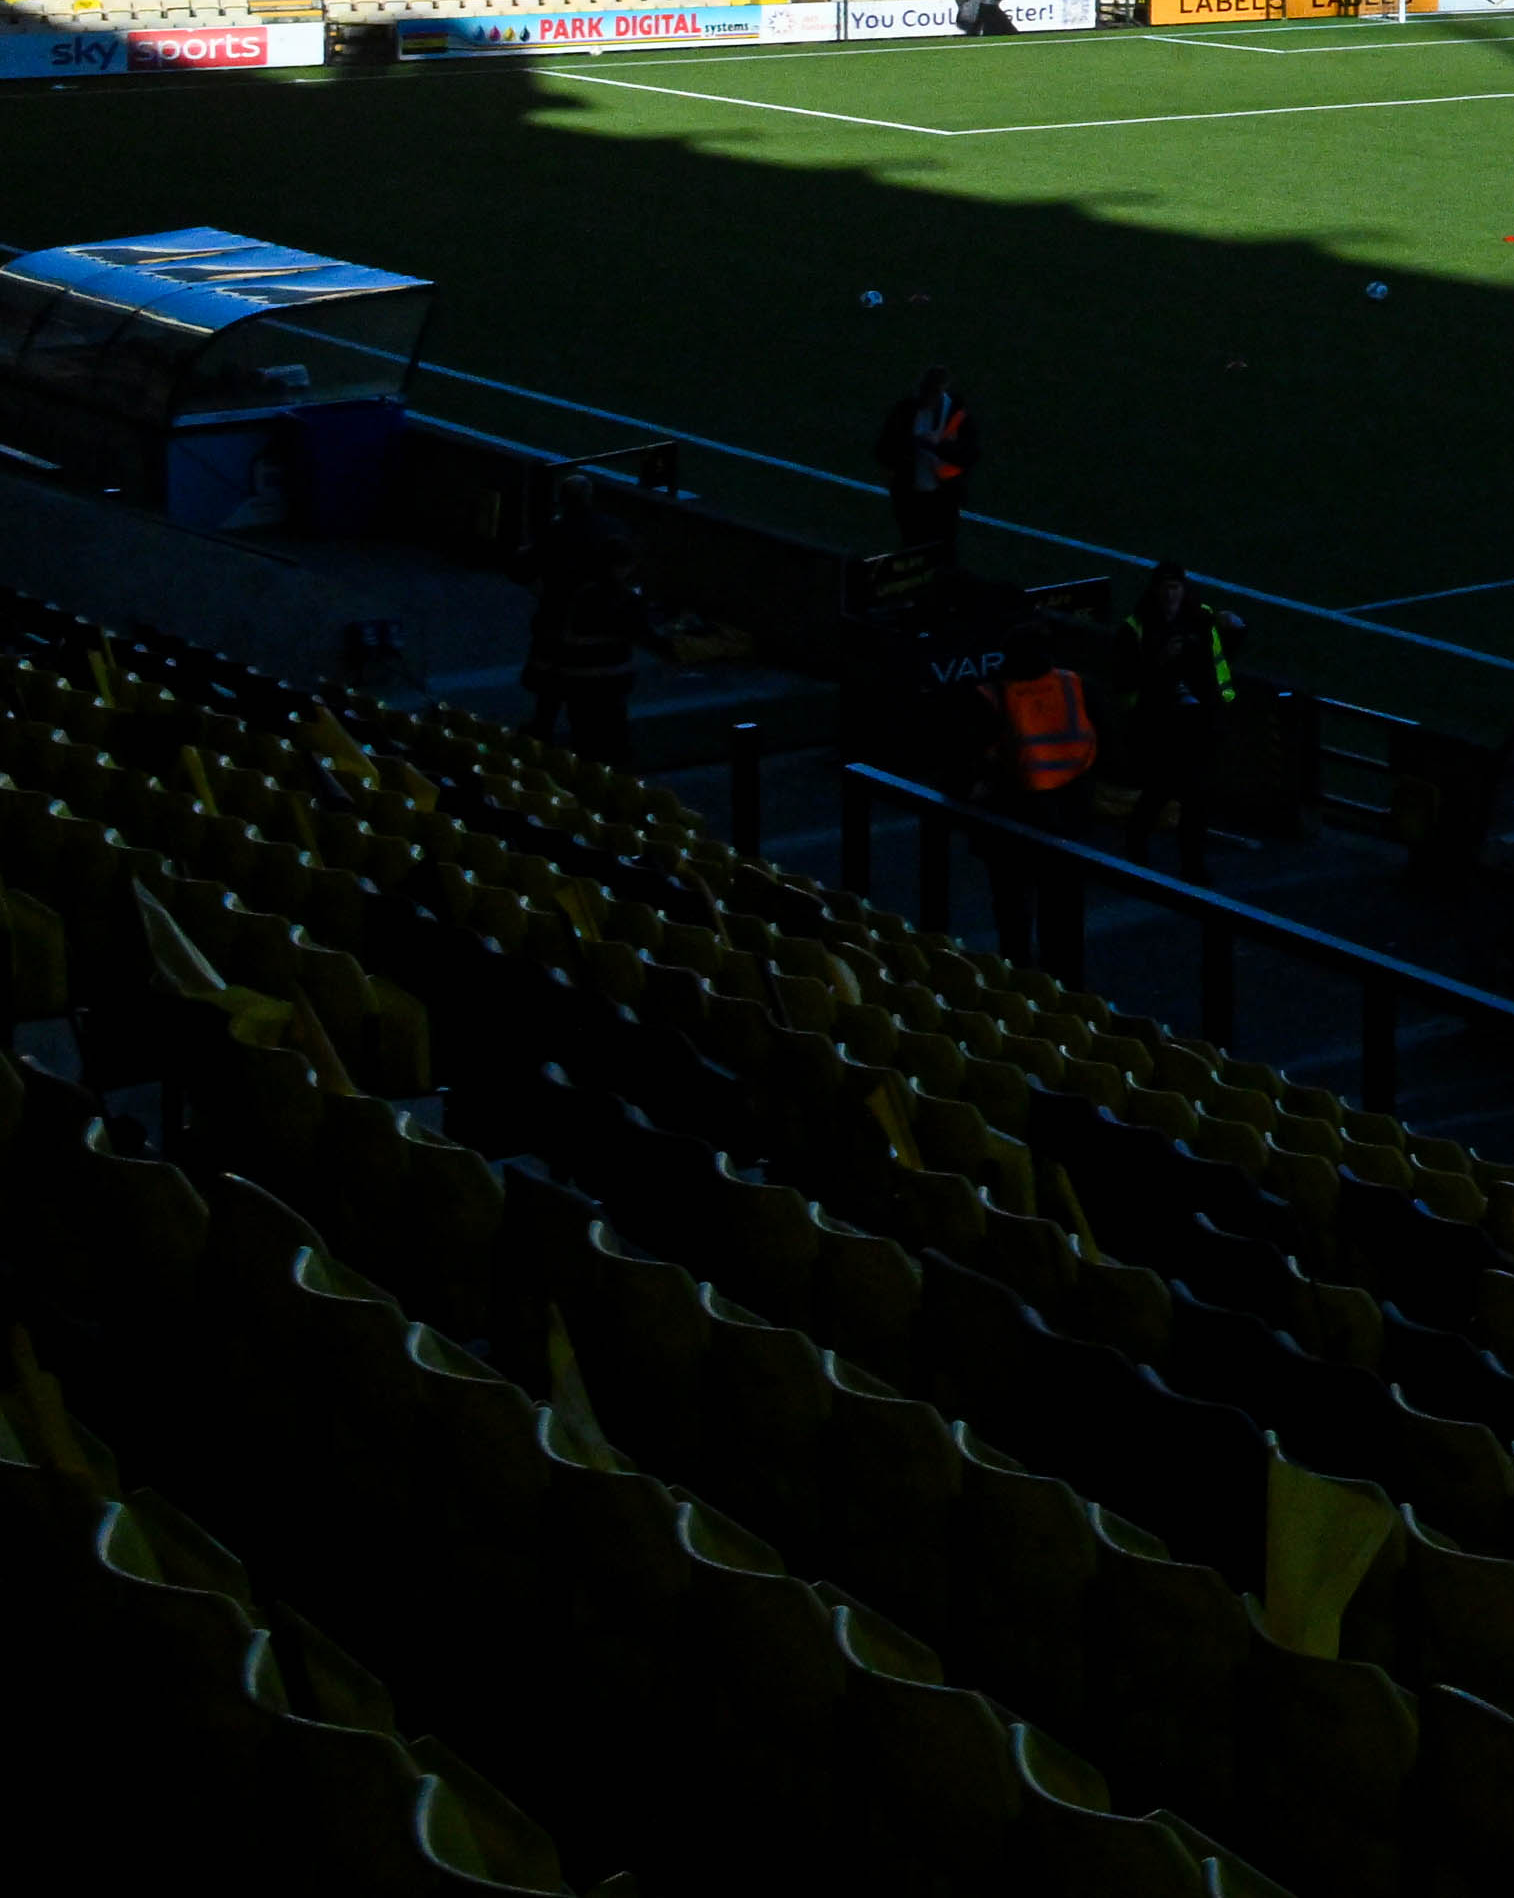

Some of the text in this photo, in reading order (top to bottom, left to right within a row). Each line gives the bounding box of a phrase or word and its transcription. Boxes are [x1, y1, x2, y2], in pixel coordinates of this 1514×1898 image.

[539, 13, 750, 40] PARK DIGITAL systems
[851, 11, 895, 30] You
[51, 32, 261, 69] sky sports
[930, 651, 1006, 685] VAR
